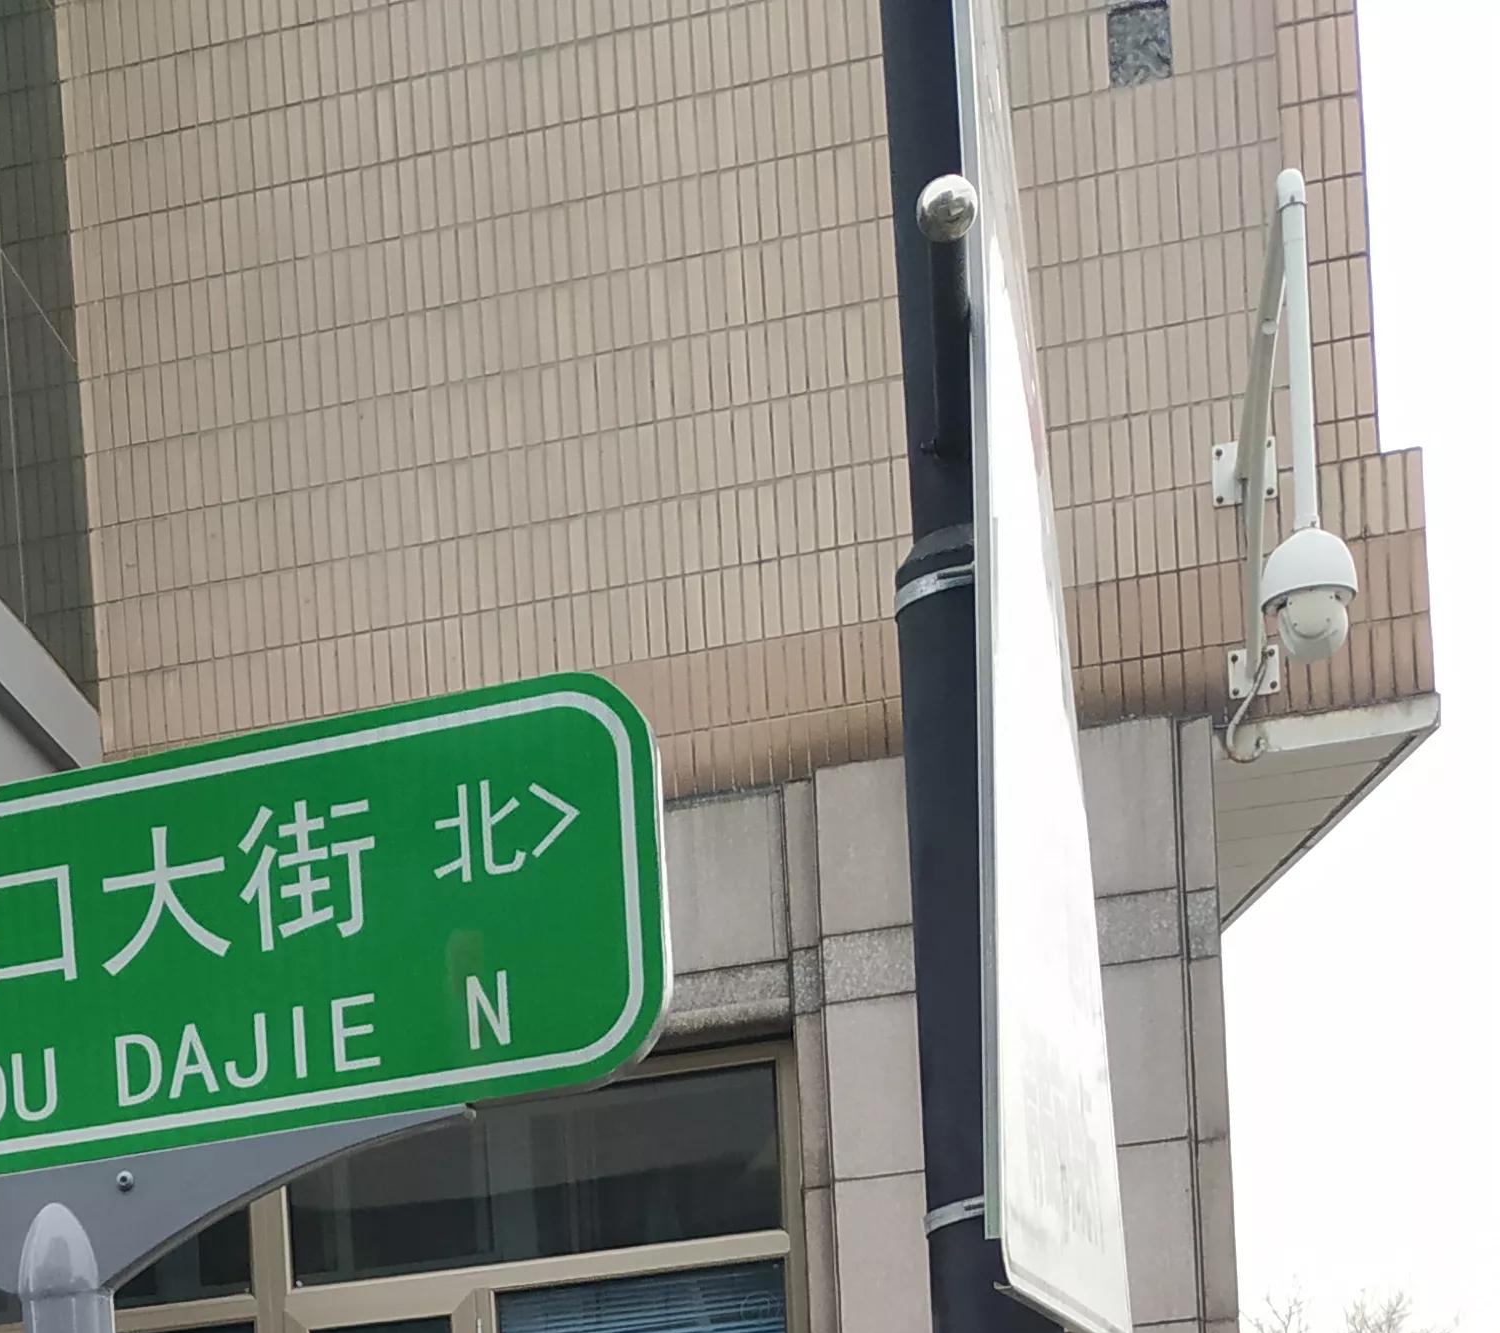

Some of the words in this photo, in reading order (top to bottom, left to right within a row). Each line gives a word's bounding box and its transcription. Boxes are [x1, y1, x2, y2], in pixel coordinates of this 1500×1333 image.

[434, 780, 526, 882] 北
[115, 993, 381, 1107] DAJIE
[466, 970, 511, 1050] N
